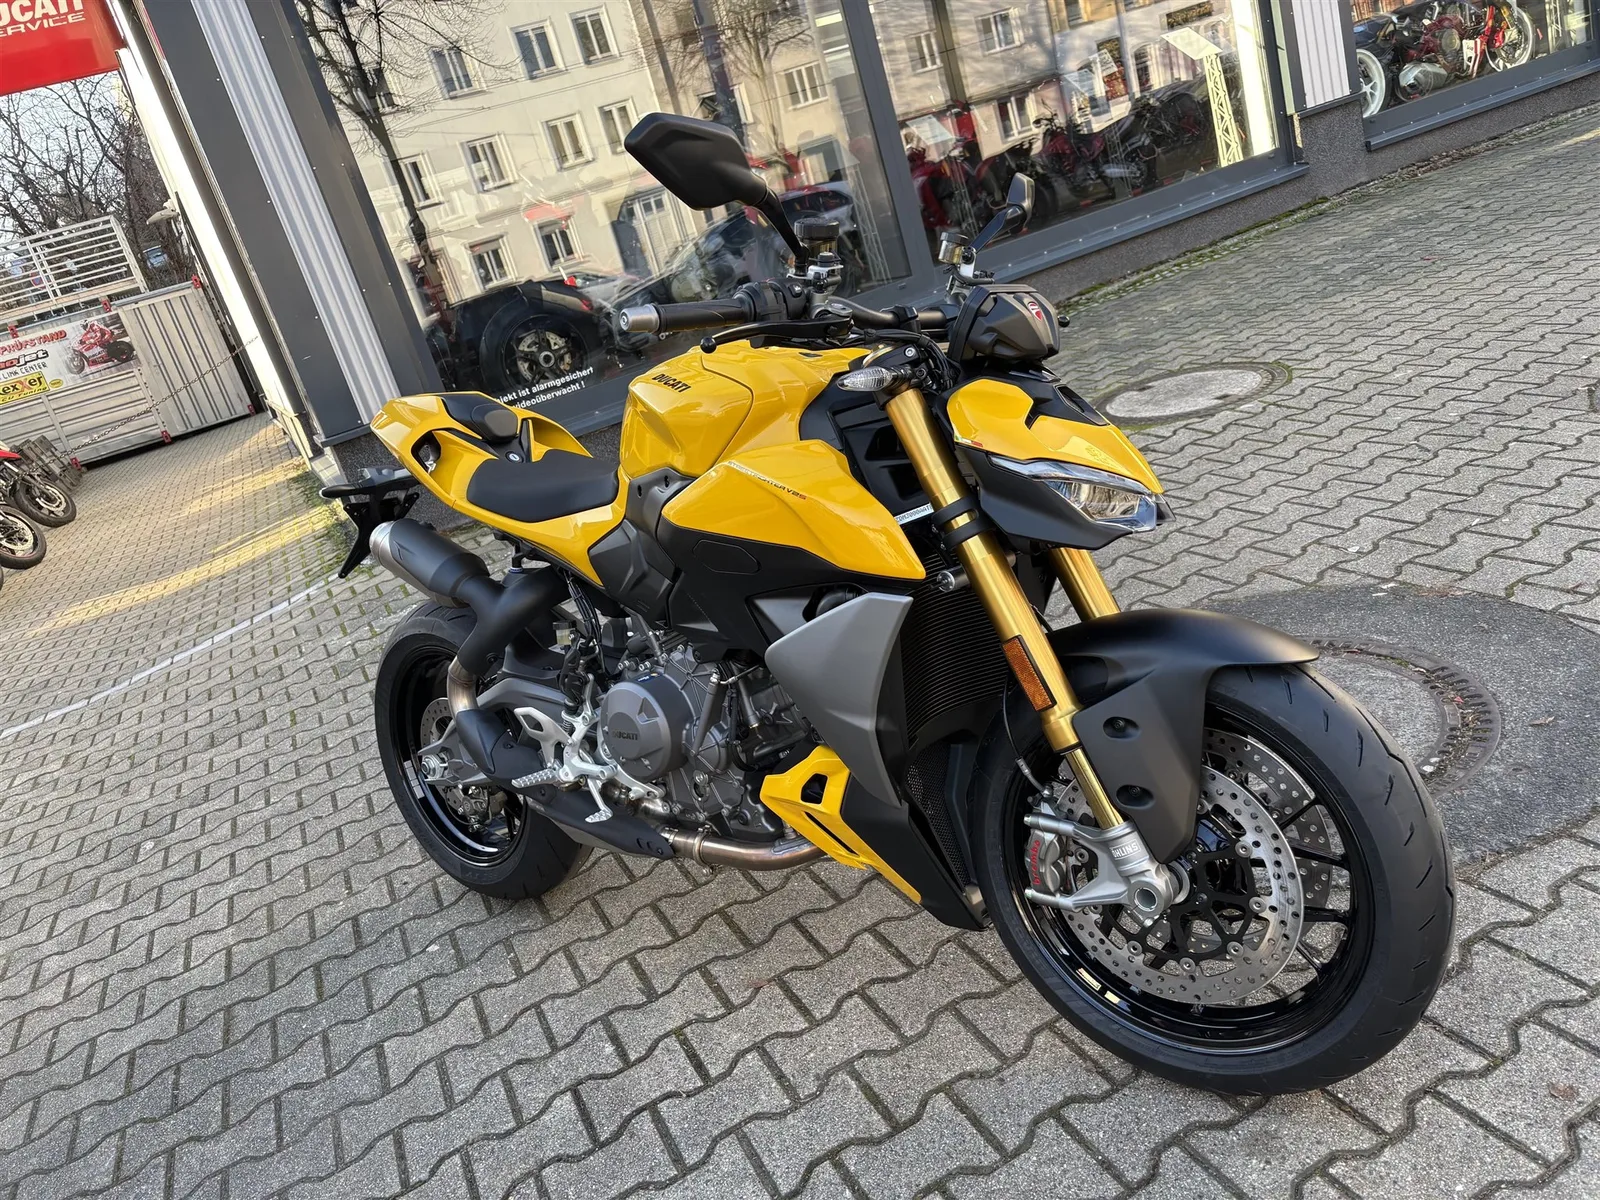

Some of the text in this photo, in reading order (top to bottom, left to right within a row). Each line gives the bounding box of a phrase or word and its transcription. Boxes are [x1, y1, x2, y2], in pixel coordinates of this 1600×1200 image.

[20, 361, 48, 375] CENTER
[518, 385, 531, 397] ist
[532, 366, 594, 393] alarmgesichert
[651, 373, 692, 393] DUCATI
[612, 731, 638, 740] DUCATI
[1030, 840, 1041, 885] brembo
